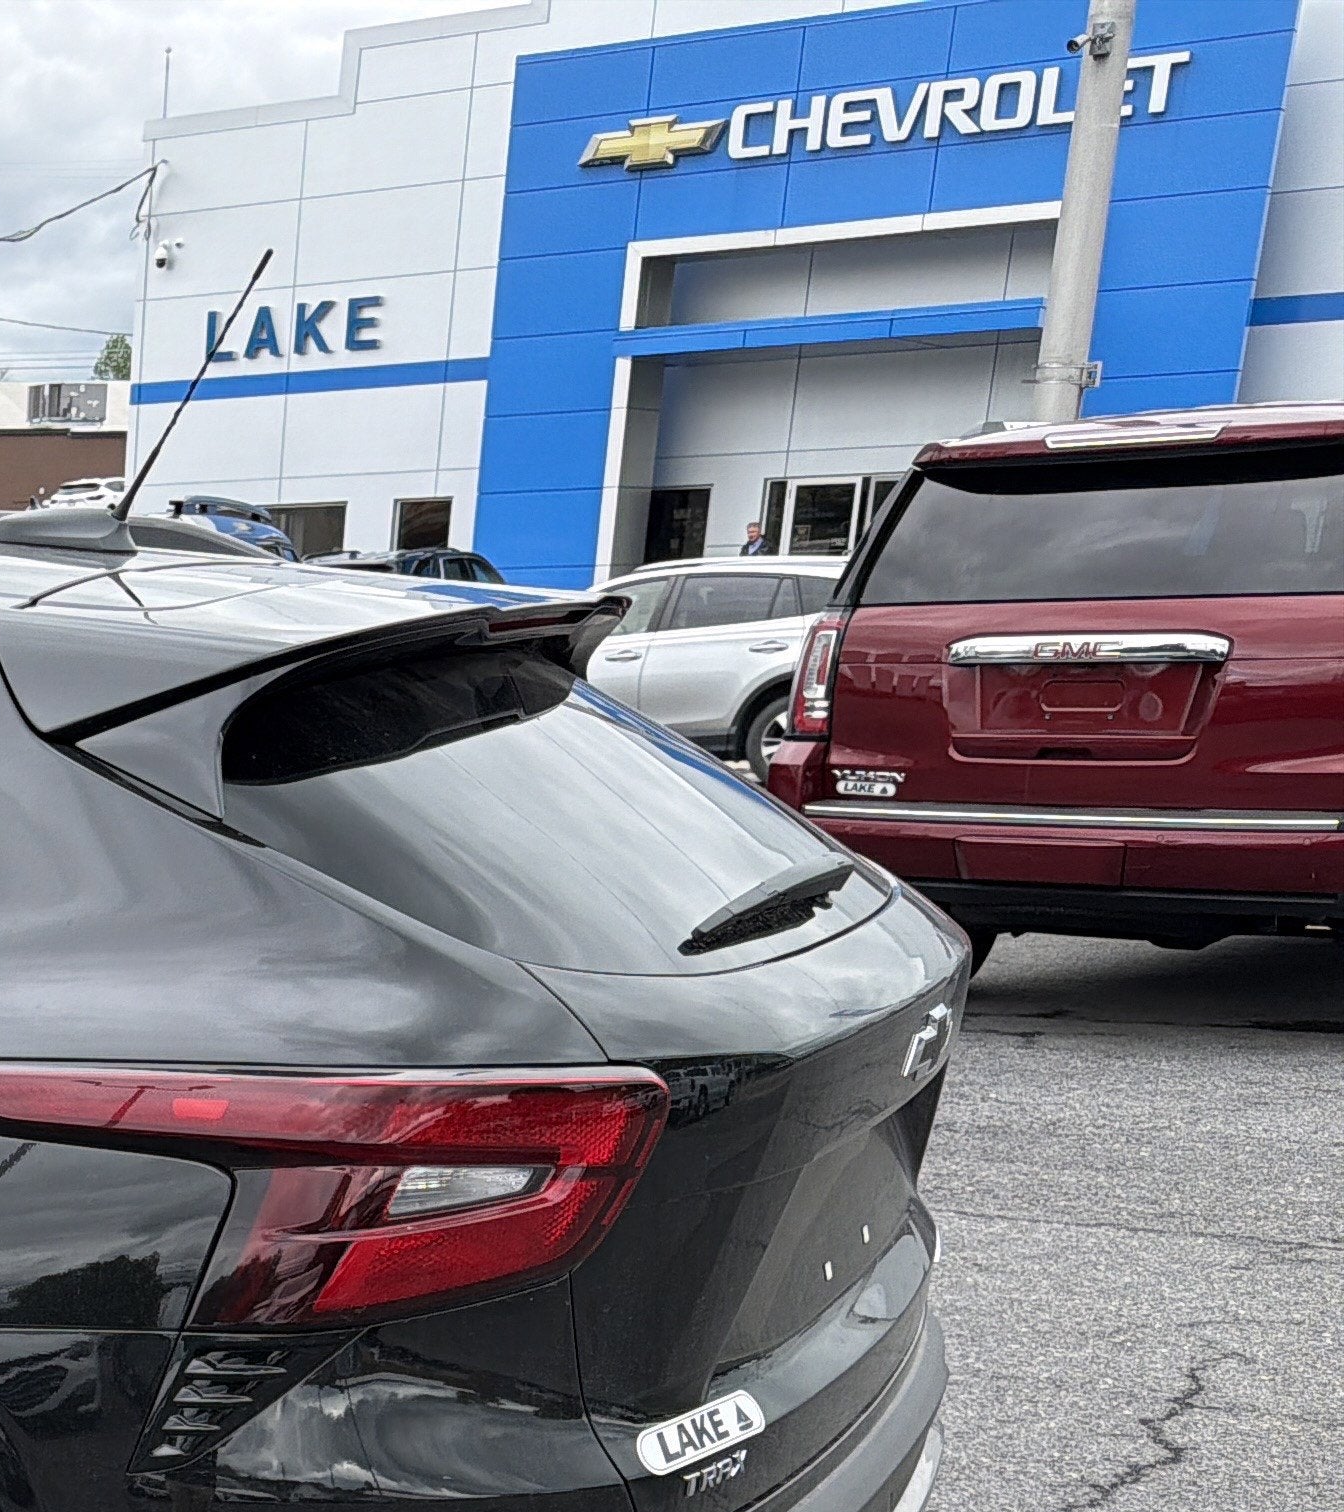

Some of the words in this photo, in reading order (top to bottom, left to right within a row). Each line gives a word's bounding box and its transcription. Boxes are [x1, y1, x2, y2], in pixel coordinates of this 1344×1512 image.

[728, 51, 1190, 160] CHEVROLT
[205, 296, 384, 363] LAKE
[1033, 641, 1123, 660] GMC
[843, 782, 876, 794] LAKE
[656, 1408, 731, 1464] LAKE
[682, 1449, 748, 1498] TRAX
